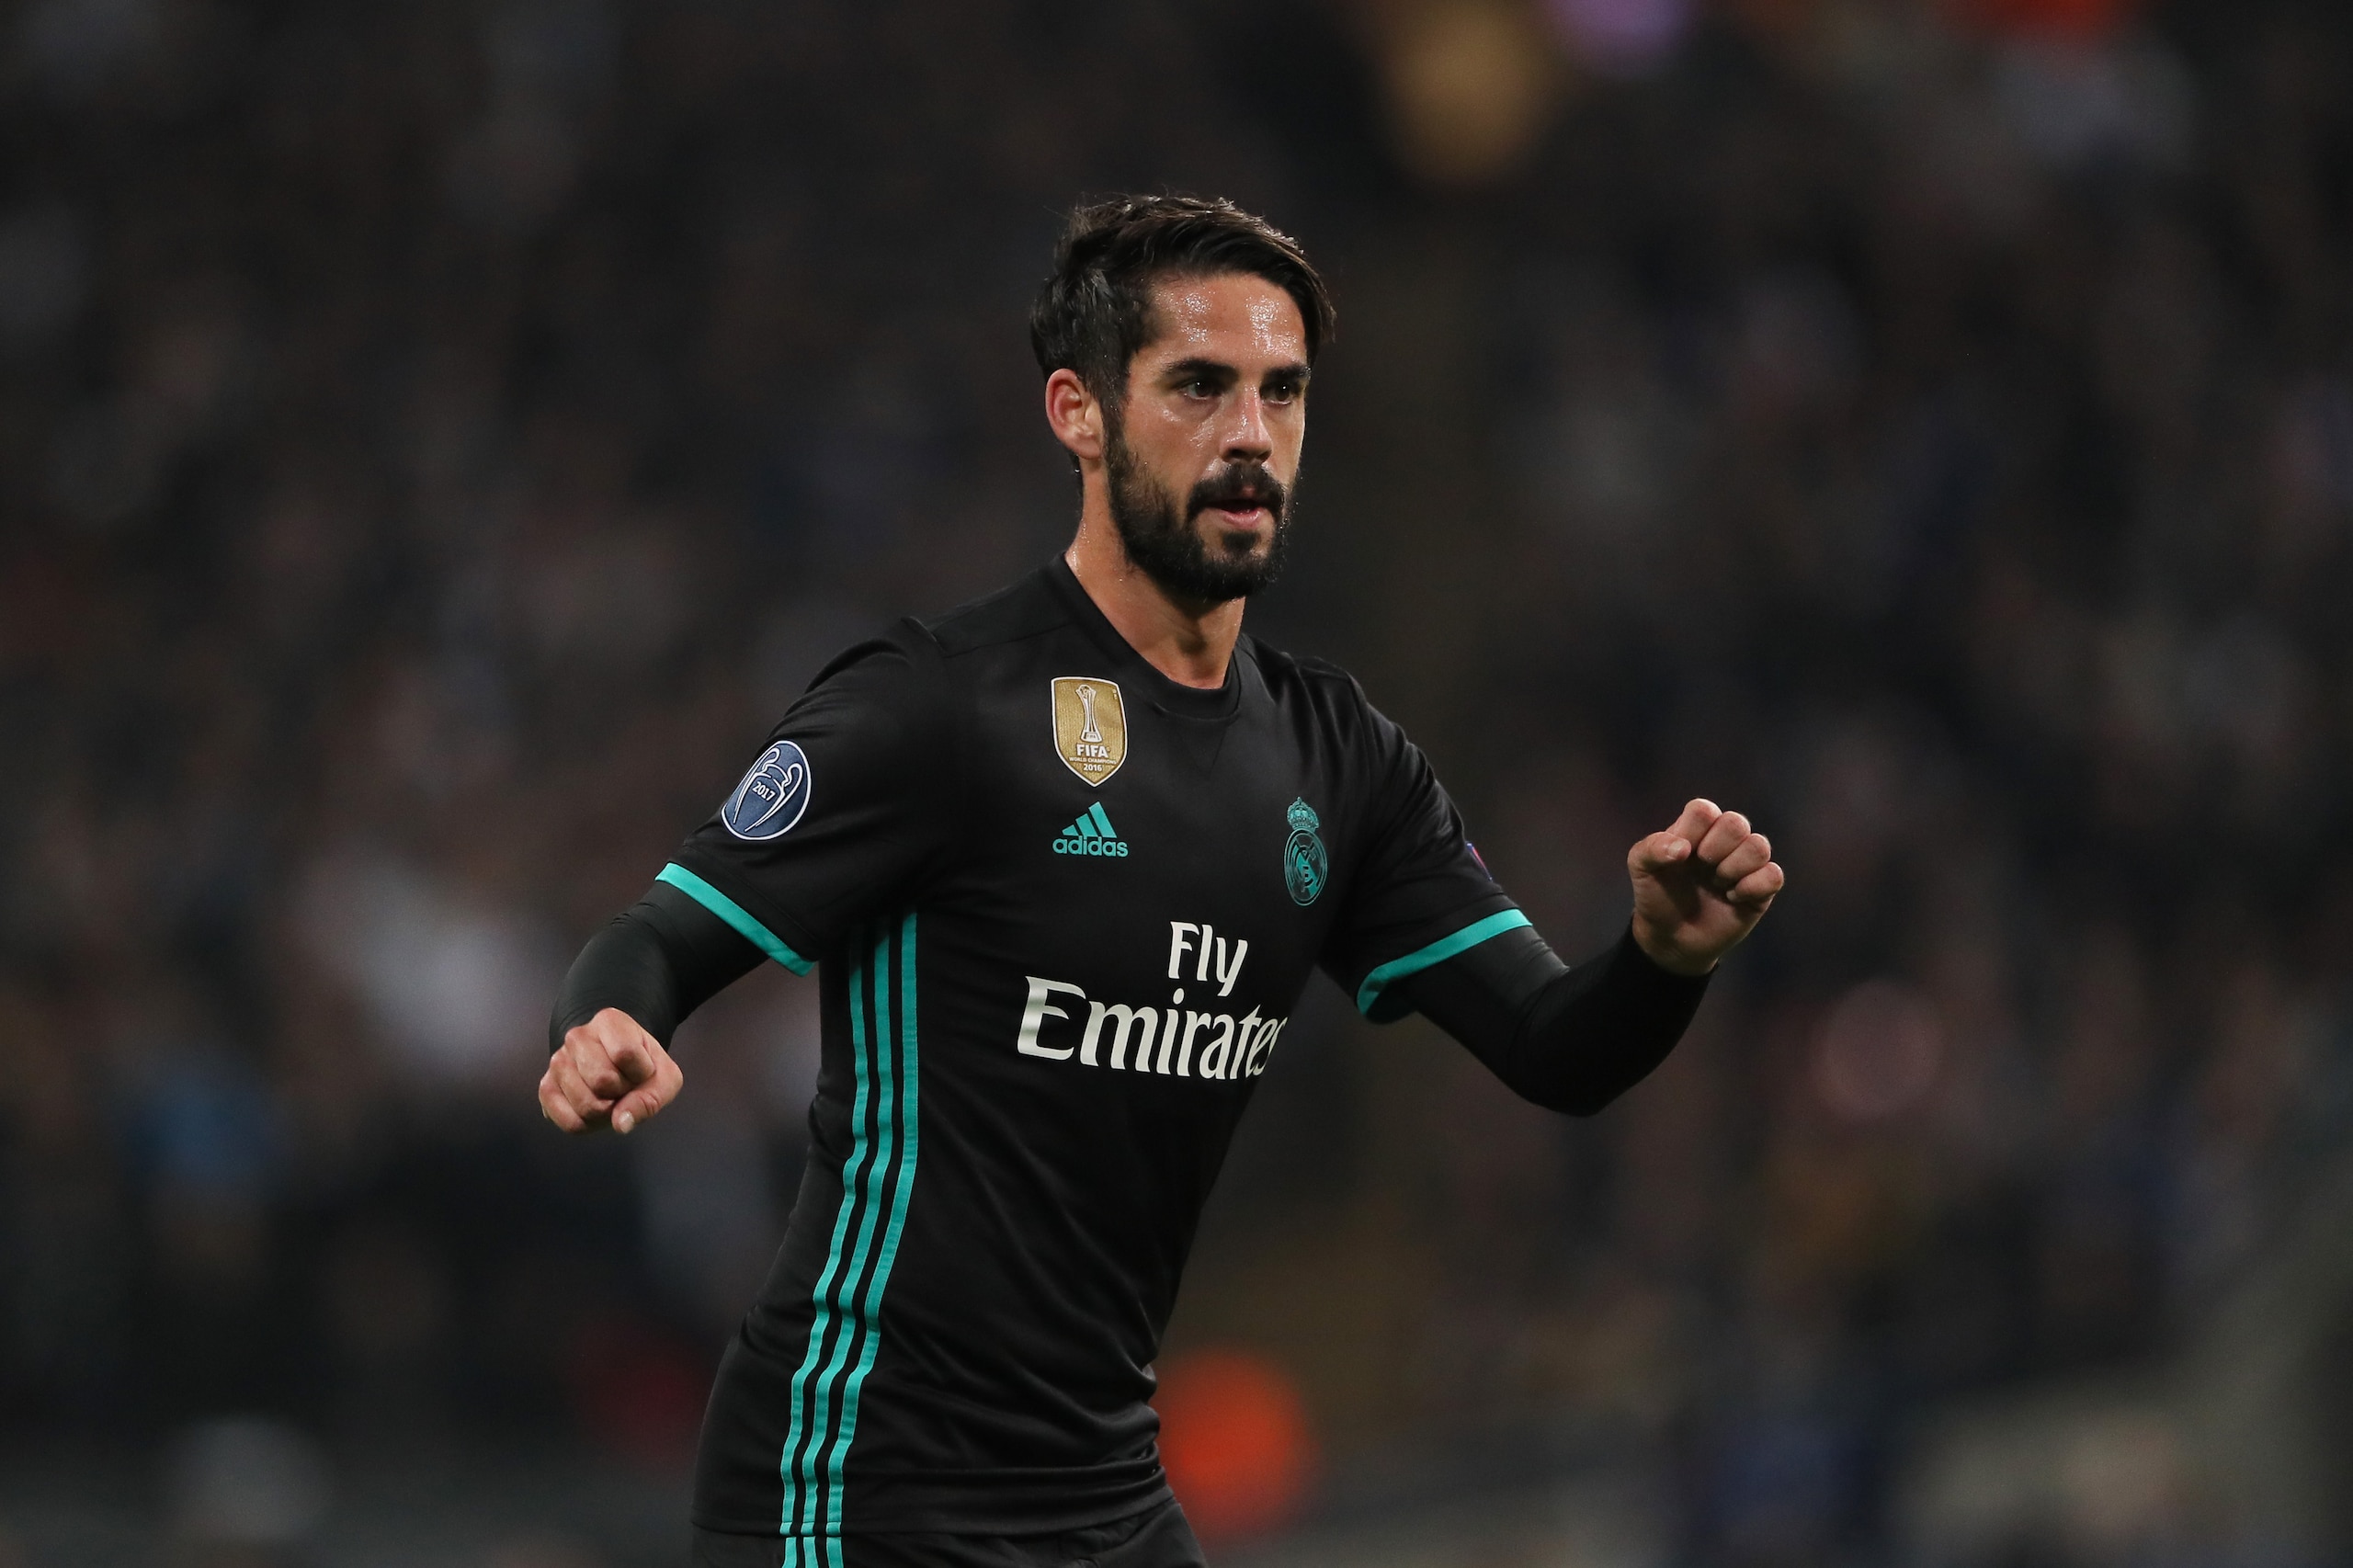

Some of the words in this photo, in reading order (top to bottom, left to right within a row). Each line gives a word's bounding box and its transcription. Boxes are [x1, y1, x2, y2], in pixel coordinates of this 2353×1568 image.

[1076, 744, 1108, 758] FIFA
[1084, 764, 1102, 772] 2016
[752, 781, 776, 801] 2017
[1052, 835, 1129, 858] adidas
[1168, 921, 1248, 997] Fly
[1017, 976, 1288, 1080] Emirates
